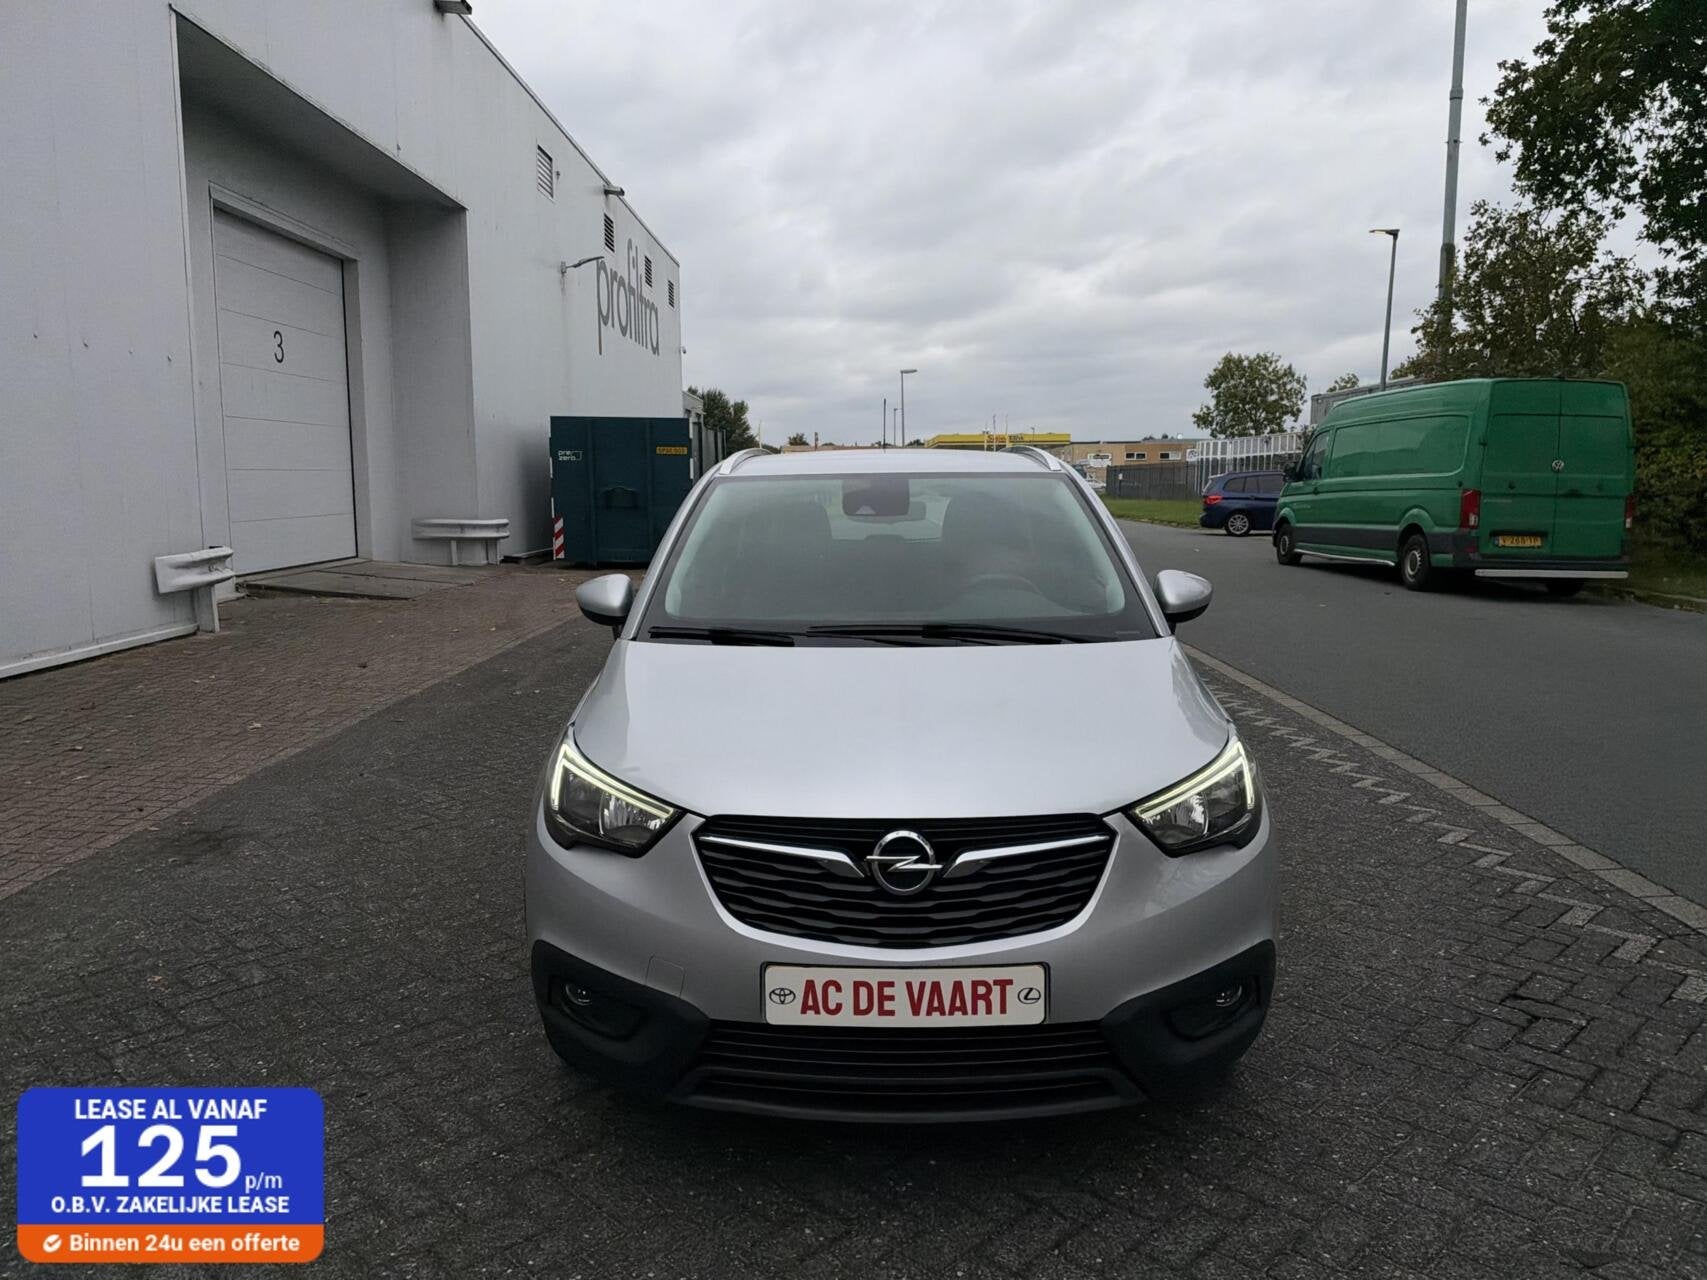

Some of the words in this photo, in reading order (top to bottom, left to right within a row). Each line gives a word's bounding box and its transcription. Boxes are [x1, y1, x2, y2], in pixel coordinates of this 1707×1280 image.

[596, 238, 660, 356] profiltra
[273, 330, 285, 364] 3
[800, 979, 843, 1015] AC
[853, 979, 895, 1016] DE
[905, 979, 1013, 1016] VAART
